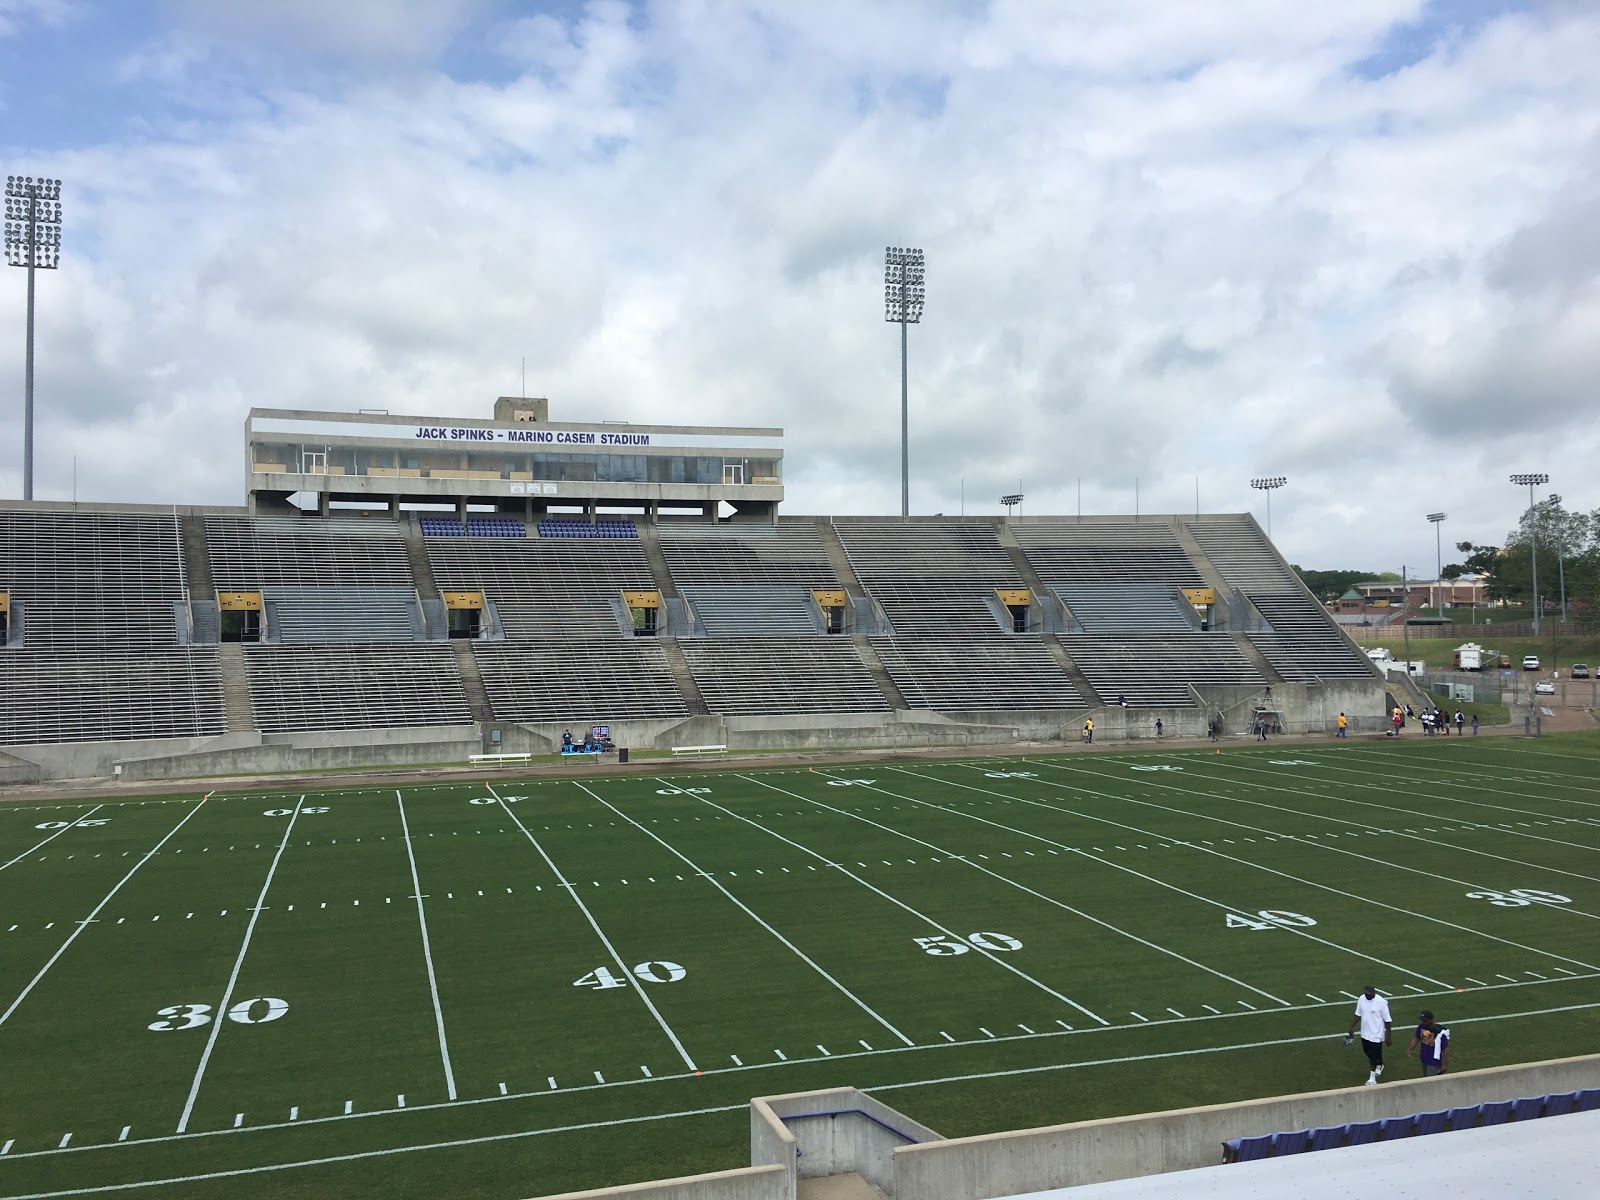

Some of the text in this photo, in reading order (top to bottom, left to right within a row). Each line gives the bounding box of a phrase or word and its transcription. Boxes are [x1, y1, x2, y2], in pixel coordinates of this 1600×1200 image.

[415, 427, 447, 439] JACK
[450, 429, 494, 441] SPINKS
[508, 431, 553, 443] MARINO
[556, 432, 595, 444] CASEM
[600, 434, 650, 445] STADIUM
[1466, 889, 1572, 907] 30
[1226, 910, 1318, 930] 40
[912, 932, 1023, 955] 50
[572, 961, 687, 990] 40
[147, 997, 289, 1031] 30
